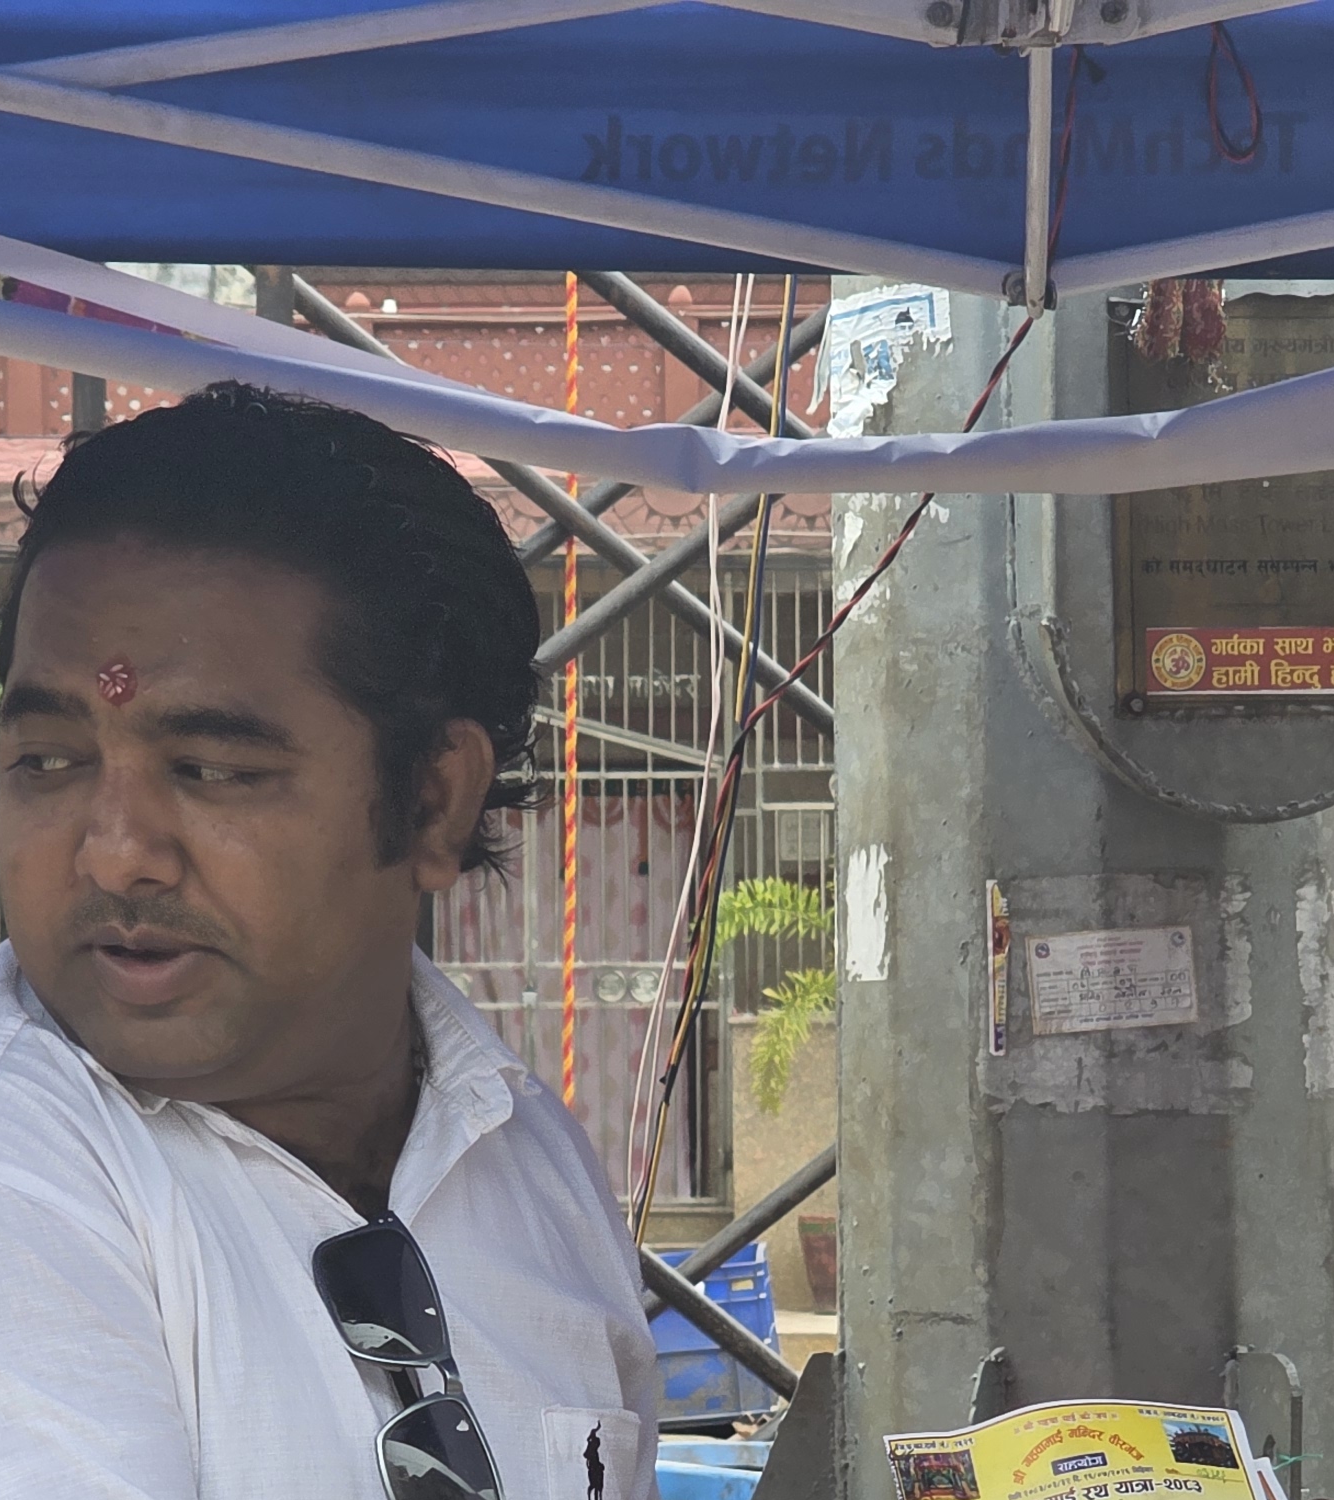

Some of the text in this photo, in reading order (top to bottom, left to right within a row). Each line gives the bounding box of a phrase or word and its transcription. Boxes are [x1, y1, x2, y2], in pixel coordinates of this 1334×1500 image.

[1211, 632, 1265, 656] गर्वका
[1274, 637, 1315, 656] साथ
[1211, 659, 1260, 688] हामी
[1270, 659, 1322, 690] हिन्दु
[1066, 1424, 1106, 1442] मन्दिर
[1081, 1480, 1110, 1500] रथ
[1113, 1477, 1204, 1496] यात्रा-२०८३
